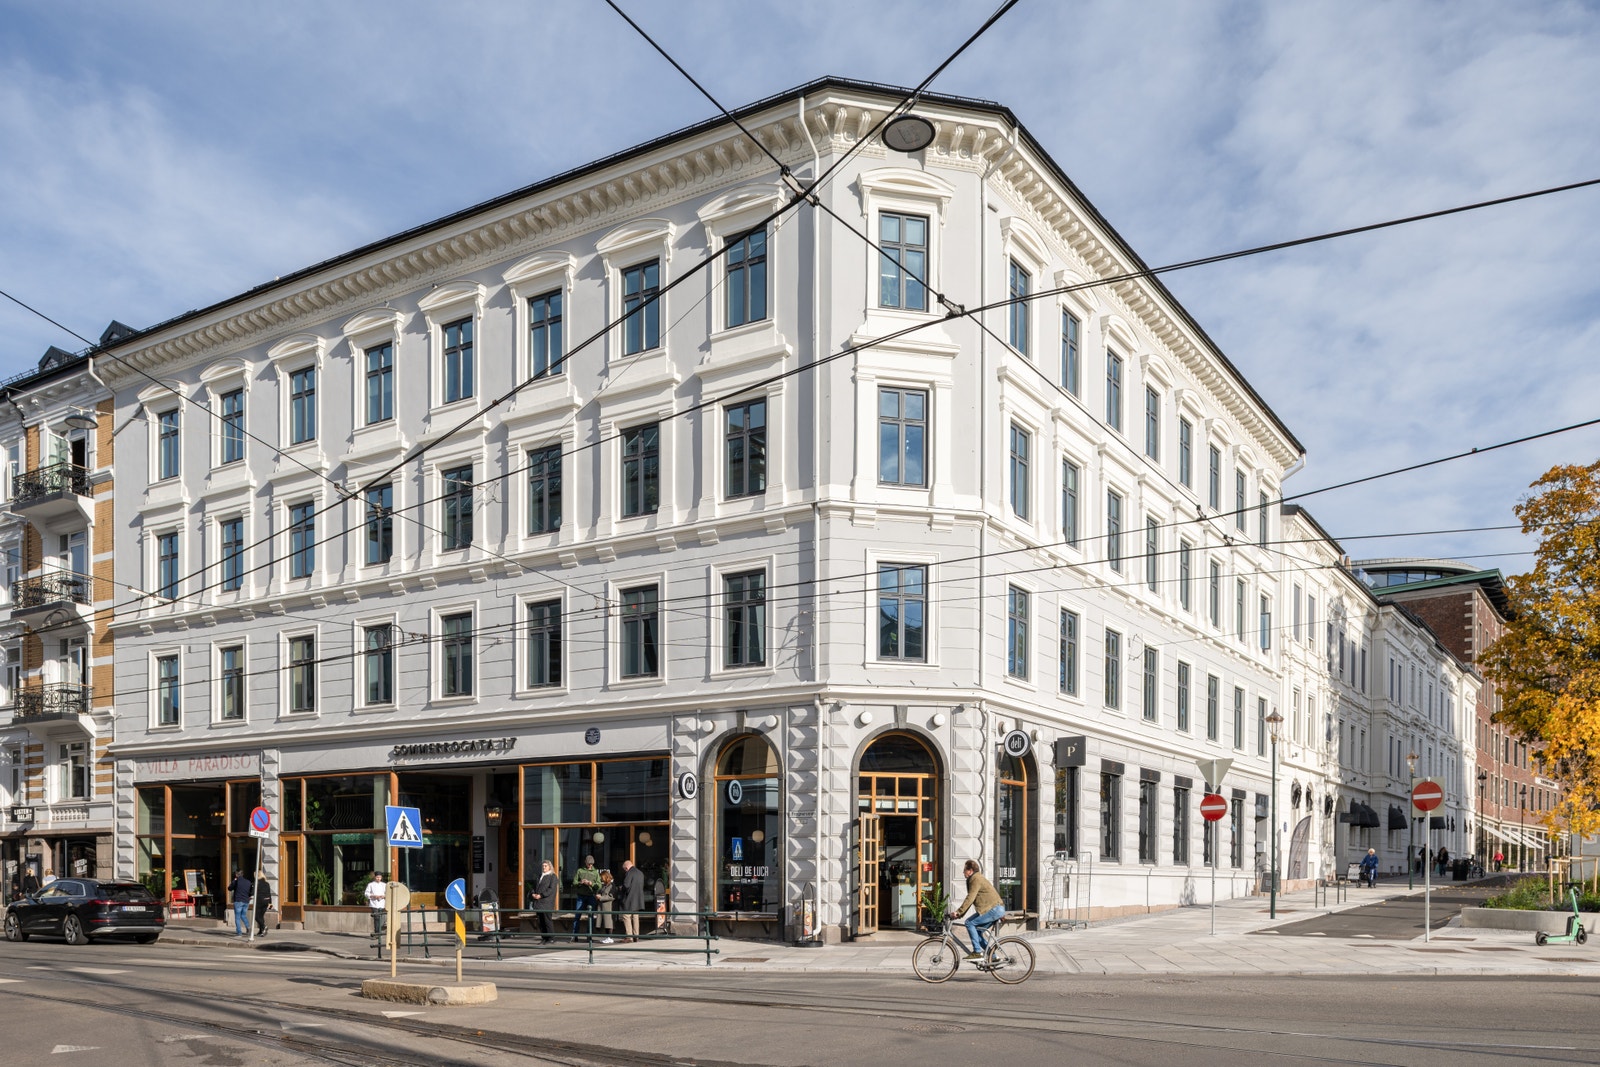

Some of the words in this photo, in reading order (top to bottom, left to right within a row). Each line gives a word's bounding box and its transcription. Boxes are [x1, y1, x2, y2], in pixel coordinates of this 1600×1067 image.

[393, 738, 494, 756] SOMMERROGATA
[502, 737, 517, 750] 17
[1010, 736, 1022, 749] deli
[146, 757, 178, 774] VILLA
[188, 753, 251, 772] PARADISO
[730, 866, 743, 877] DELI
[744, 866, 752, 876] DE
[753, 866, 769, 877] LUCA
